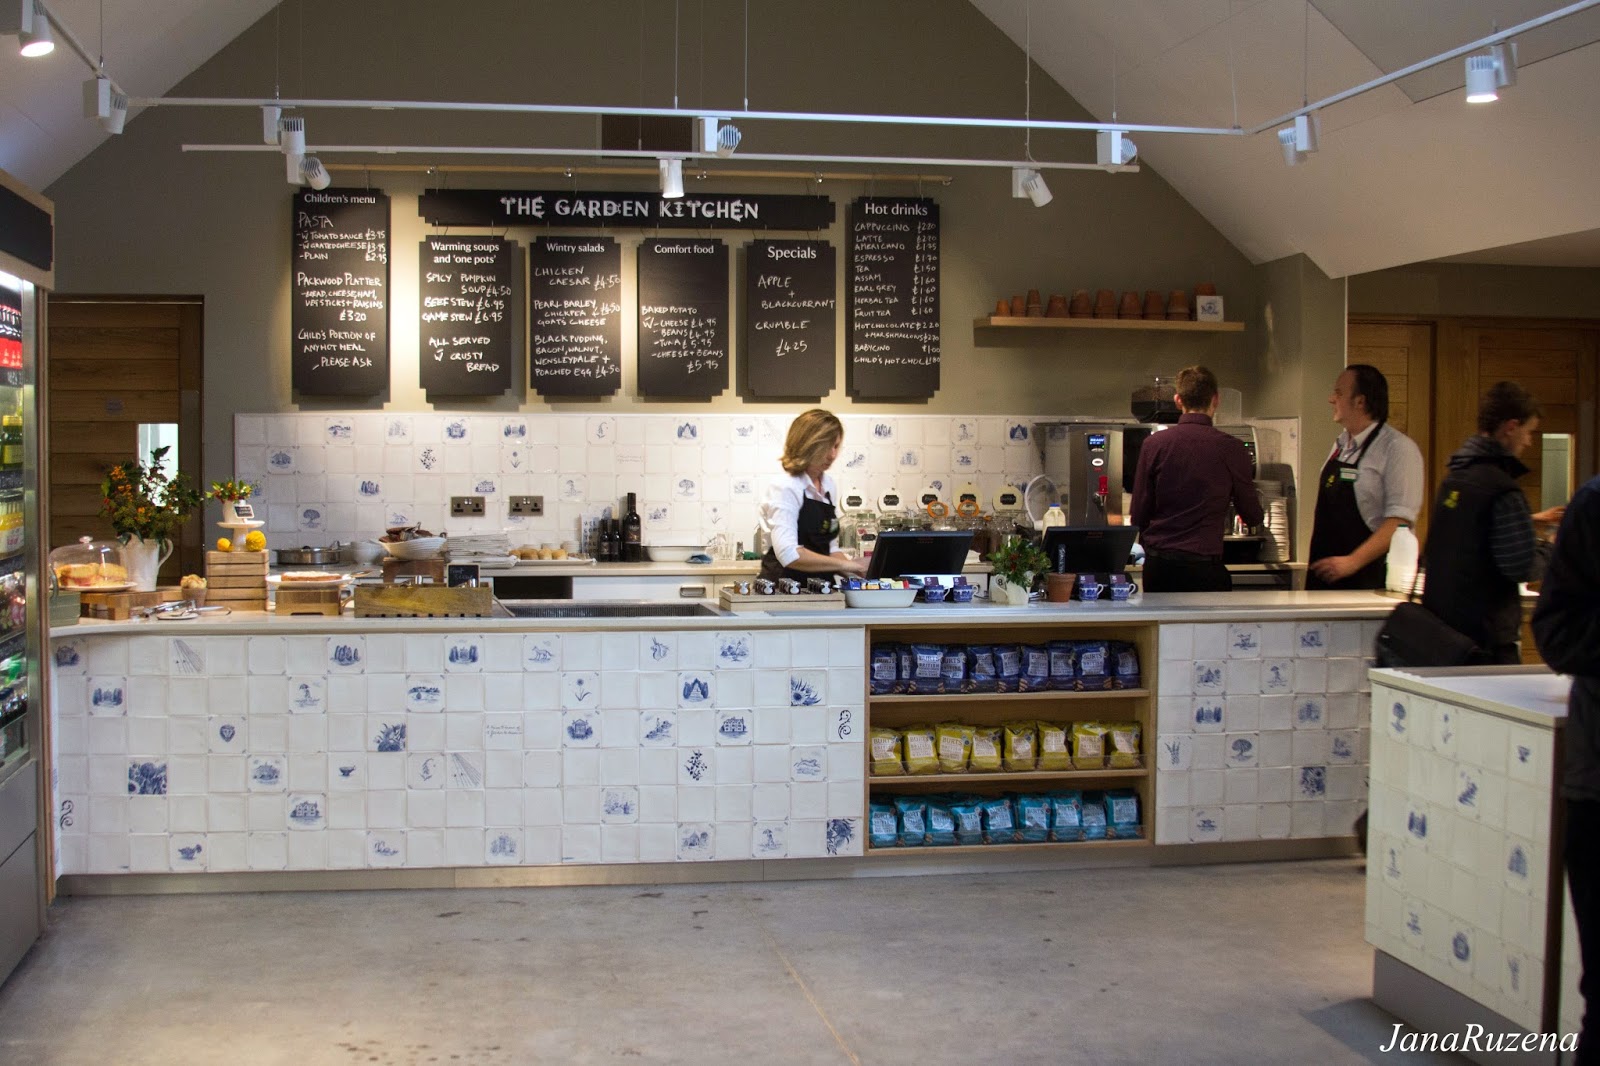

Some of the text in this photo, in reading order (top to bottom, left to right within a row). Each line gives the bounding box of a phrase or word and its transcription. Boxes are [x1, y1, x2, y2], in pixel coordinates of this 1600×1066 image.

[304, 194, 376, 204] Children's menu
[500, 195, 759, 222] THE GARDEN KITCHEN
[865, 203, 928, 216] Hot drinks
[299, 211, 334, 228] PASTA
[854, 222, 910, 232] CAPPUCCINO
[310, 231, 338, 240] TOMATO
[855, 235, 883, 243] LATTE
[336, 242, 366, 250] CHEESE
[431, 242, 499, 253] Warming soups
[546, 243, 605, 253] Wintry salads
[654, 244, 714, 254] Comfort food
[854, 242, 905, 251] AMERICANO
[767, 246, 817, 260] Specials
[433, 254, 451, 263] and
[854, 255, 895, 263] ESPRESSO
[535, 266, 584, 276] CHICKEN
[855, 265, 870, 273] TEA
[297, 272, 382, 287] PACKWOOD PLATTER
[426, 272, 496, 283] SPICY PUMPKIN
[549, 277, 591, 286] CAESAR
[757, 274, 792, 289] APPLE
[854, 274, 881, 282] ASSAM
[461, 285, 486, 294] SOUP
[854, 285, 874, 293] EARL
[876, 285, 897, 293] GREY
[320, 299, 345, 307] STICKS
[353, 300, 384, 309] RAISINS
[424, 296, 449, 307] BEEF
[451, 298, 474, 307] STEW
[534, 300, 562, 310] PEARL
[761, 299, 835, 310] BLACKCURRANT
[854, 297, 883, 305] HERBAL
[641, 305, 697, 316] BAKED POTATO
[854, 308, 874, 318] FRUIT
[876, 309, 891, 317] TEA
[422, 311, 449, 323] GAME
[450, 312, 472, 322] STEW
[569, 318, 606, 326] CHEESE
[755, 320, 811, 330] CRUMBLE
[854, 322, 870, 331] HOT
[298, 329, 376, 341] CHILD'S PORTION OF
[661, 329, 688, 337] BEANS
[429, 336, 490, 348] ALL SERVED
[534, 334, 568, 345] BLACK
[303, 343, 366, 353] ANY HOT MEAL
[854, 344, 890, 352] BABYCINO
[450, 352, 483, 360] CRUSTY
[696, 349, 724, 358] BEANS
[321, 356, 372, 367] PLEASE ASK
[535, 356, 599, 366] WENSLEYDALE
[885, 358, 900, 366] HOT
[466, 362, 499, 372] BREAD
[535, 368, 572, 376] POACHED
[573, 368, 592, 377] EGG
